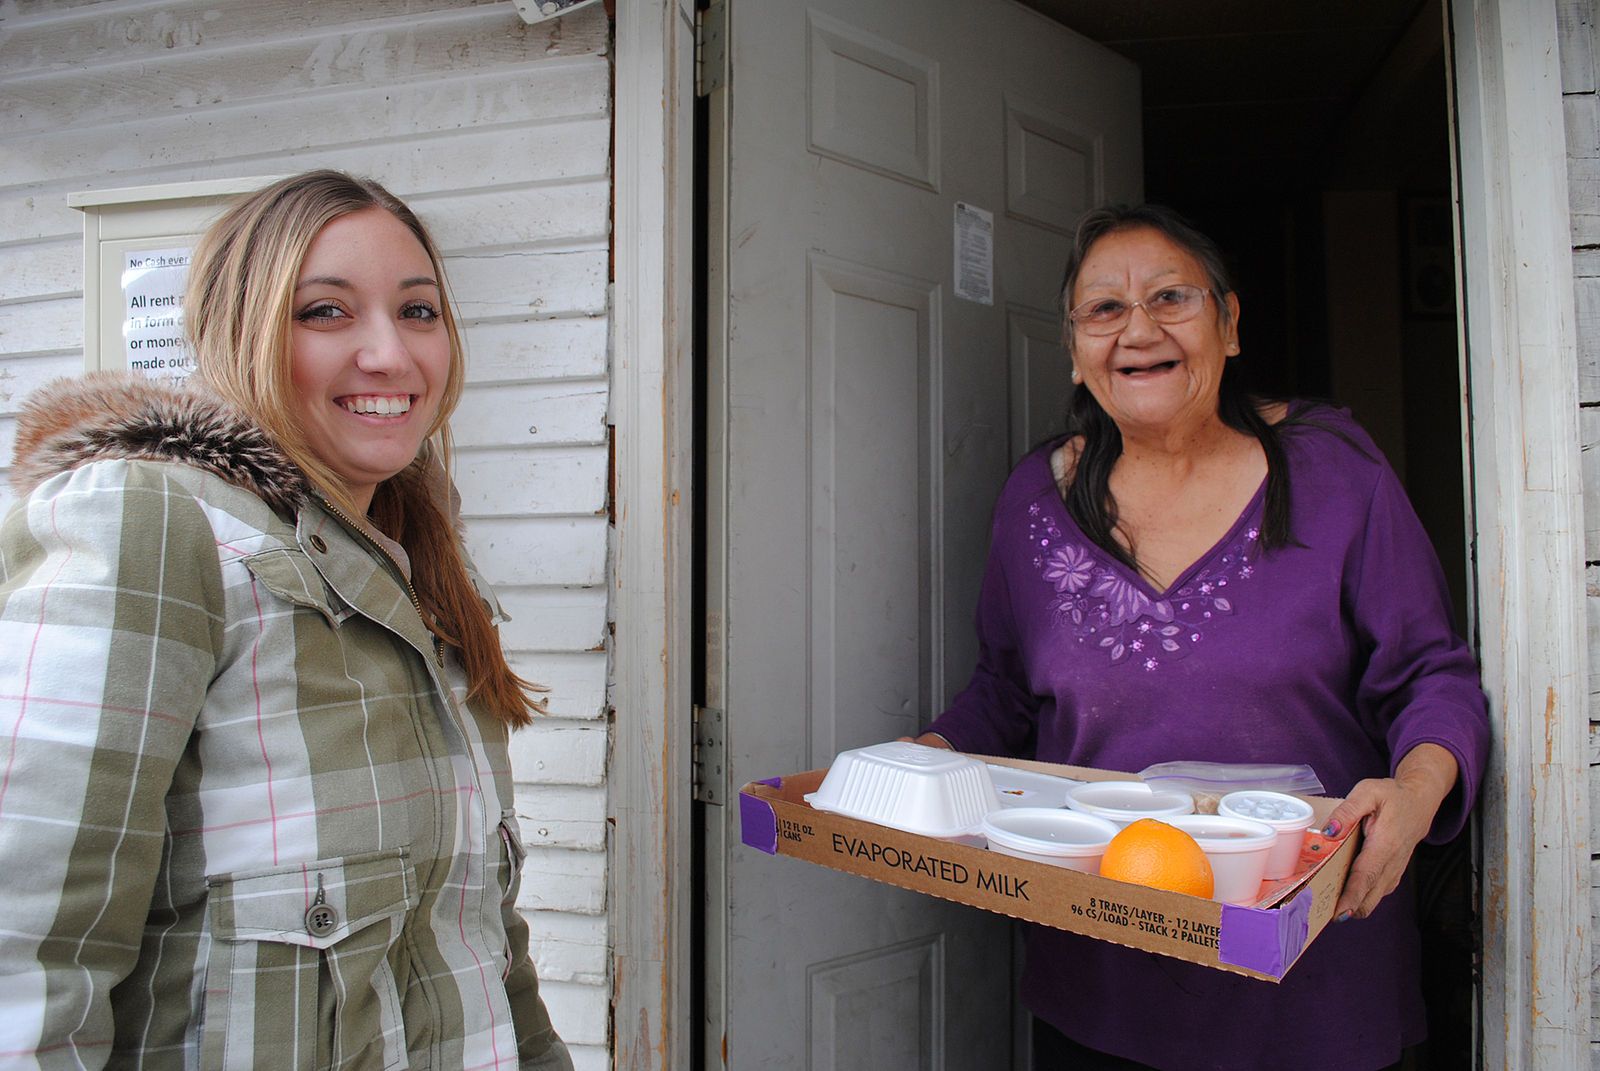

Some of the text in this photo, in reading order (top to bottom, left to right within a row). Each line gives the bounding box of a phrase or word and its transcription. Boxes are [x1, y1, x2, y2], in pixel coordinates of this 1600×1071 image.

[130, 256, 189, 268] No Cash ever
[131, 295, 147, 309] All
[150, 295, 176, 307] rent
[131, 317, 142, 328] in
[145, 315, 174, 328] form
[130, 337, 187, 349] or money
[132, 356, 165, 369] made
[169, 356, 190, 368] out
[782, 819, 792, 830] 12
[793, 822, 801, 832] FL
[783, 830, 802, 842] CANS
[832, 833, 1030, 901] EVAPORATED MILK
[1090, 897, 1097, 908] 8
[1098, 899, 1165, 924] TRAYS/LAYER
[1176, 917, 1189, 930] 12
[1071, 904, 1083, 916] 96
[1085, 908, 1129, 927] CS/LOAD
[1138, 920, 1168, 937] STACK
[1171, 928, 1178, 939] 2
[1181, 930, 1220, 949] PALLETS
